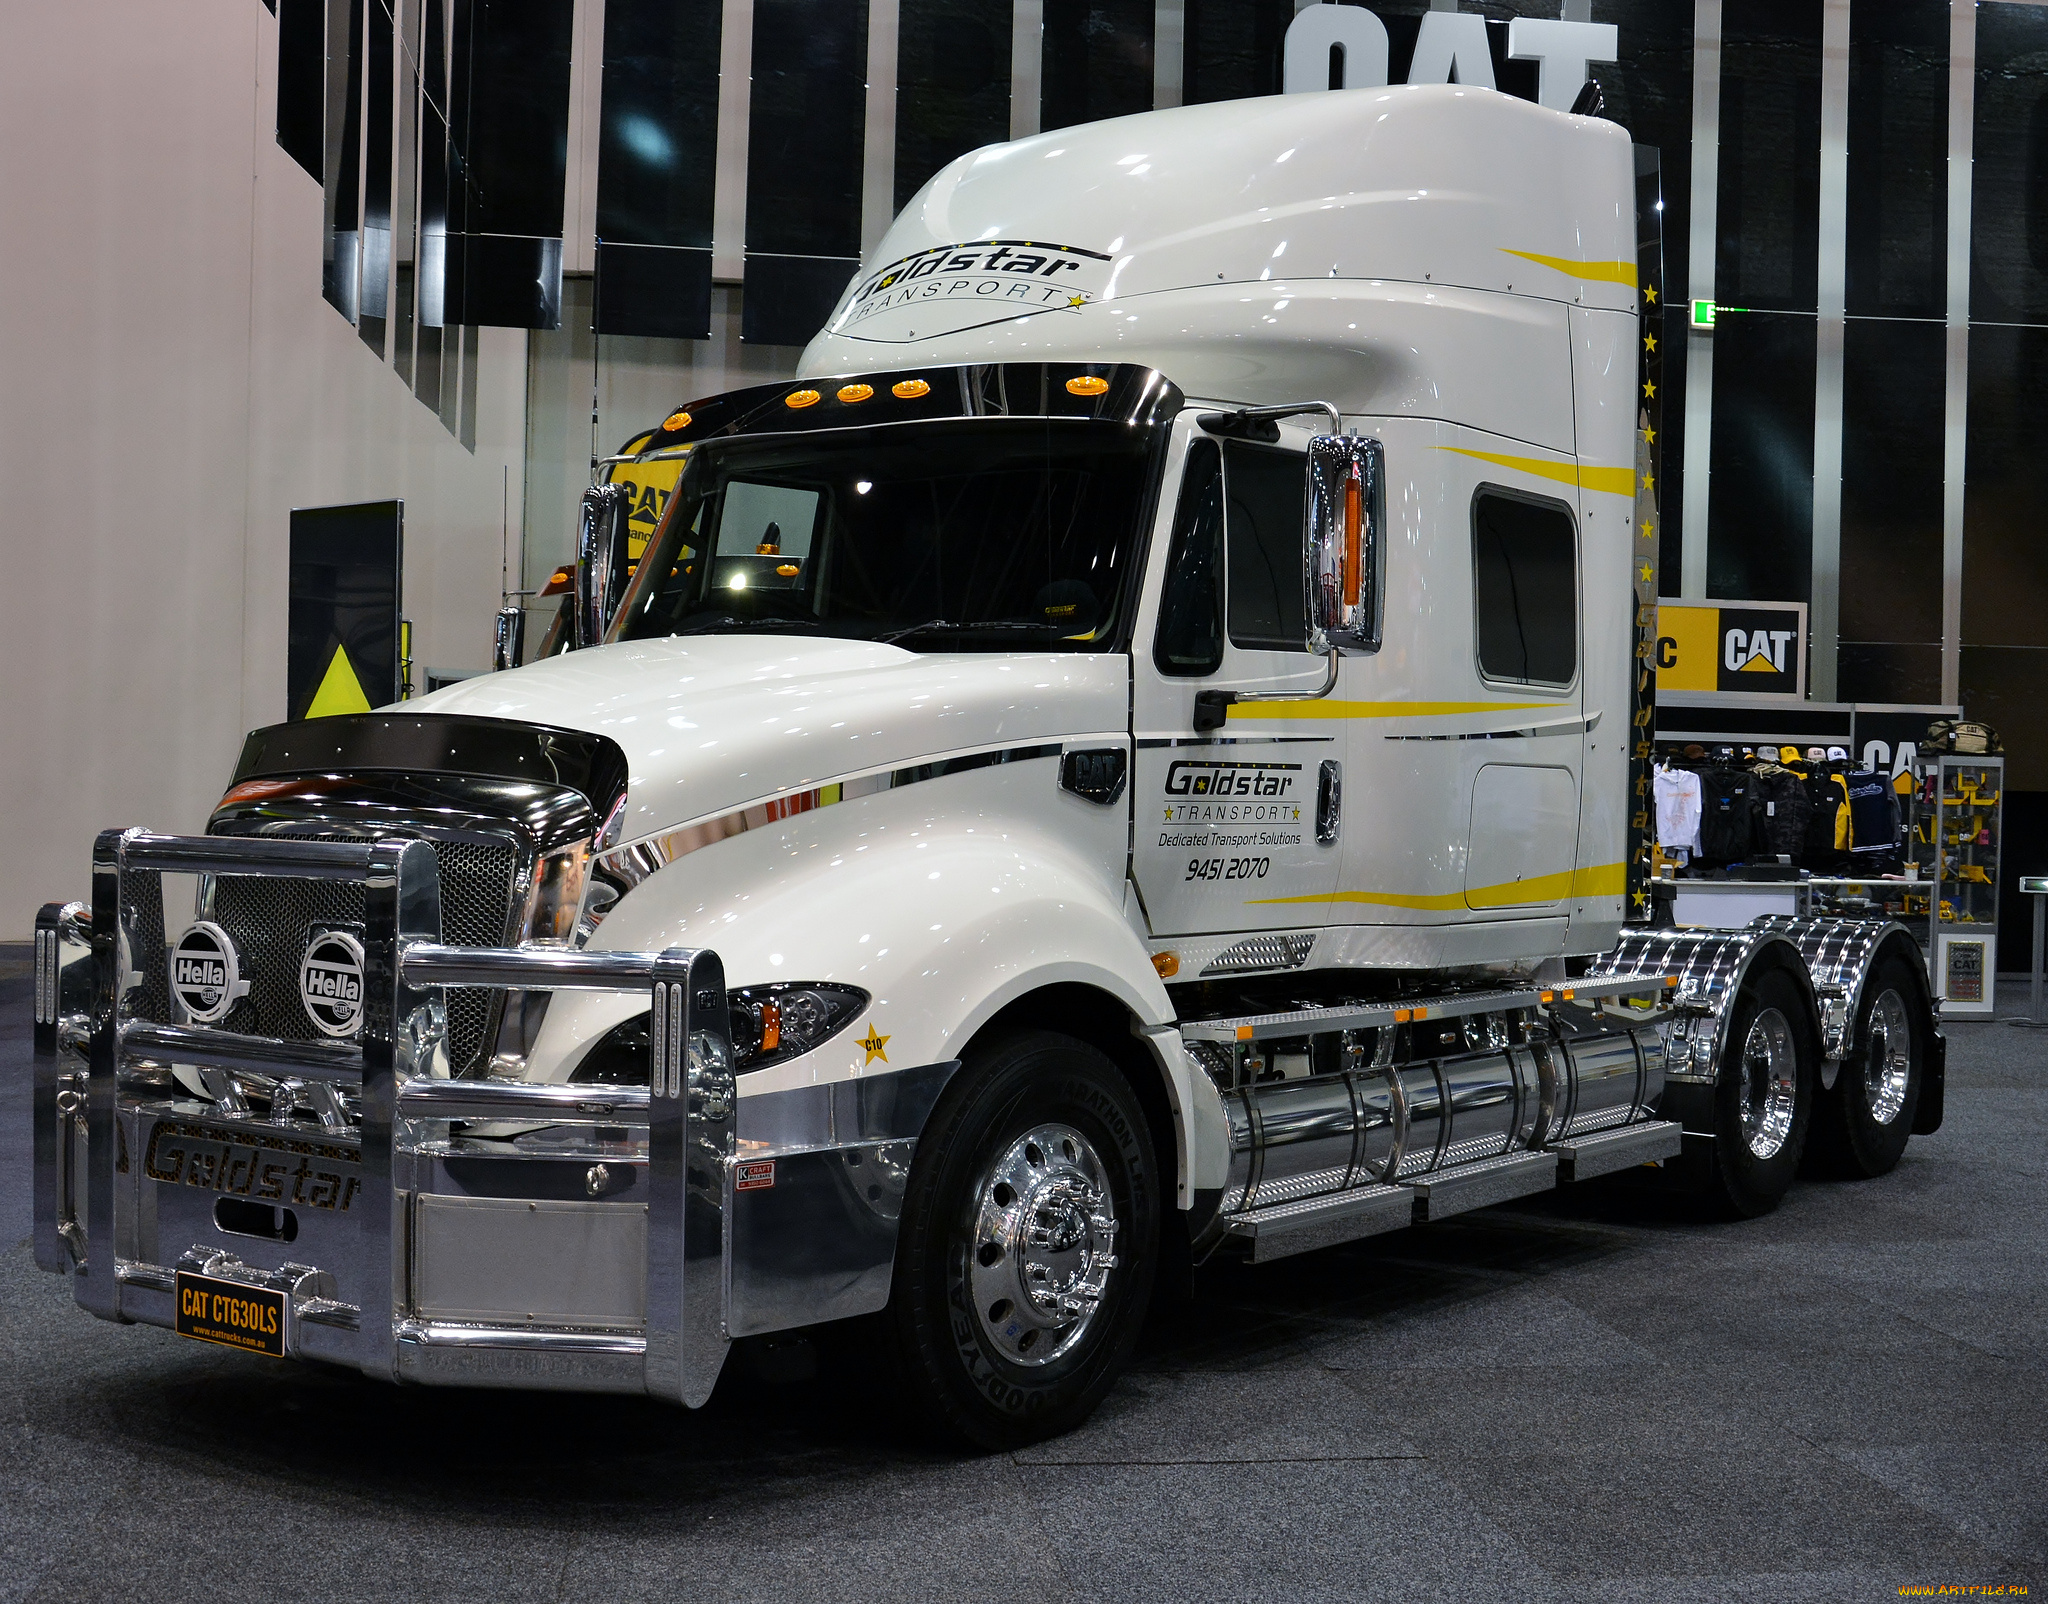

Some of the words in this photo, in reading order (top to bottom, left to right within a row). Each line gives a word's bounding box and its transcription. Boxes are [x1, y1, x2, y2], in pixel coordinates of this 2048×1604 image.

[1724, 628, 1791, 673] CAT
[1165, 760, 1302, 796] Goldstar
[1176, 805, 1290, 821] TRANSPORT
[1158, 832, 1208, 847] Dedicated
[1211, 832, 1257, 849] Transport
[1258, 831, 1301, 846] Solutions
[1185, 858, 1225, 881] 9451
[1225, 857, 1270, 879] 2070
[178, 959, 225, 985] Hella
[308, 970, 359, 1000] Hella
[865, 1038, 882, 1052] C10
[146, 1121, 361, 1211] Goldstar
[750, 1165, 771, 1175] CRAFT
[182, 1288, 209, 1319] CAT
[212, 1294, 277, 1335] CT630LS
[193, 1325, 266, 1348] www.cattrucks.com.au
